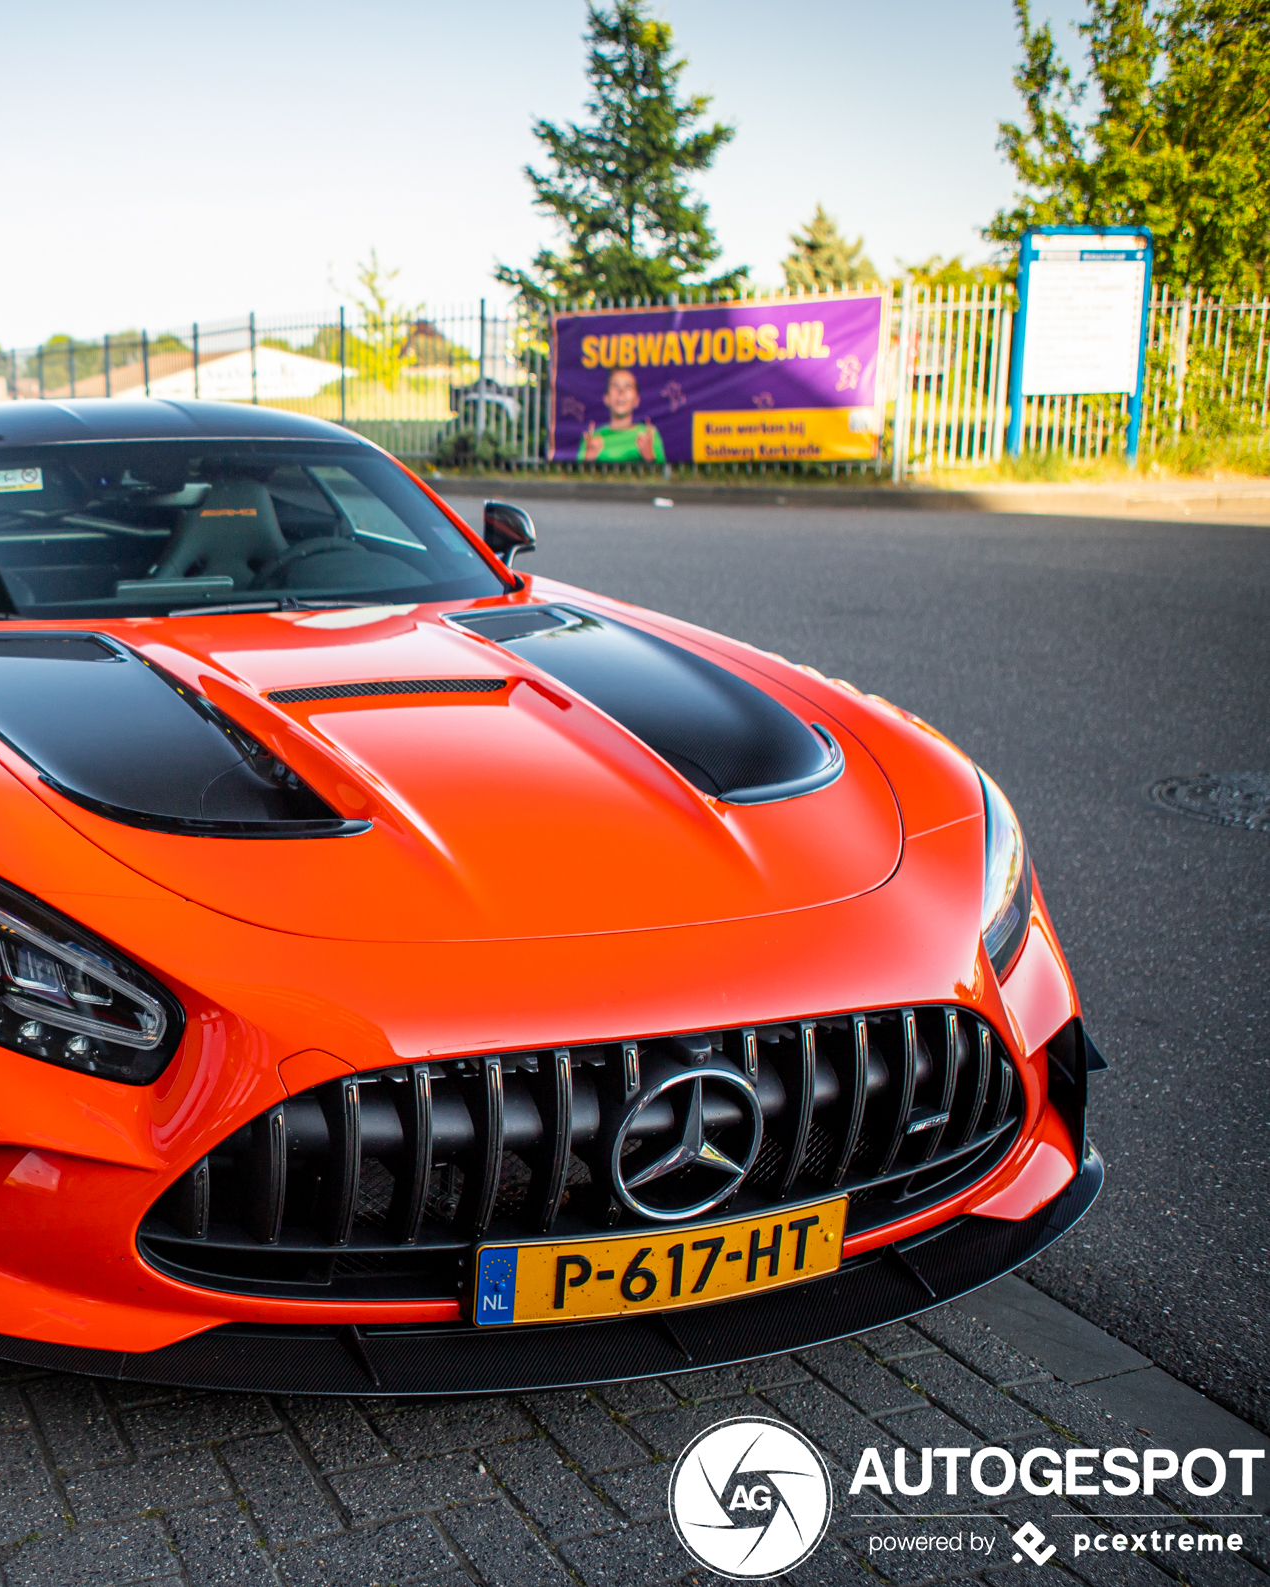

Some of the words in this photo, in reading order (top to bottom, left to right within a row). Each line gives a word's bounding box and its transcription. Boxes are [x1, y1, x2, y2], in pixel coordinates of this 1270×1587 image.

[581, 321, 830, 368] SUBWAYJOBS.NL
[706, 423, 733, 435] Kom
[737, 422, 785, 435] werken
[788, 421, 805, 437] bij
[706, 444, 754, 459] Subway
[553, 1215, 819, 1309] P-617-HT
[483, 1295, 508, 1311] NL
